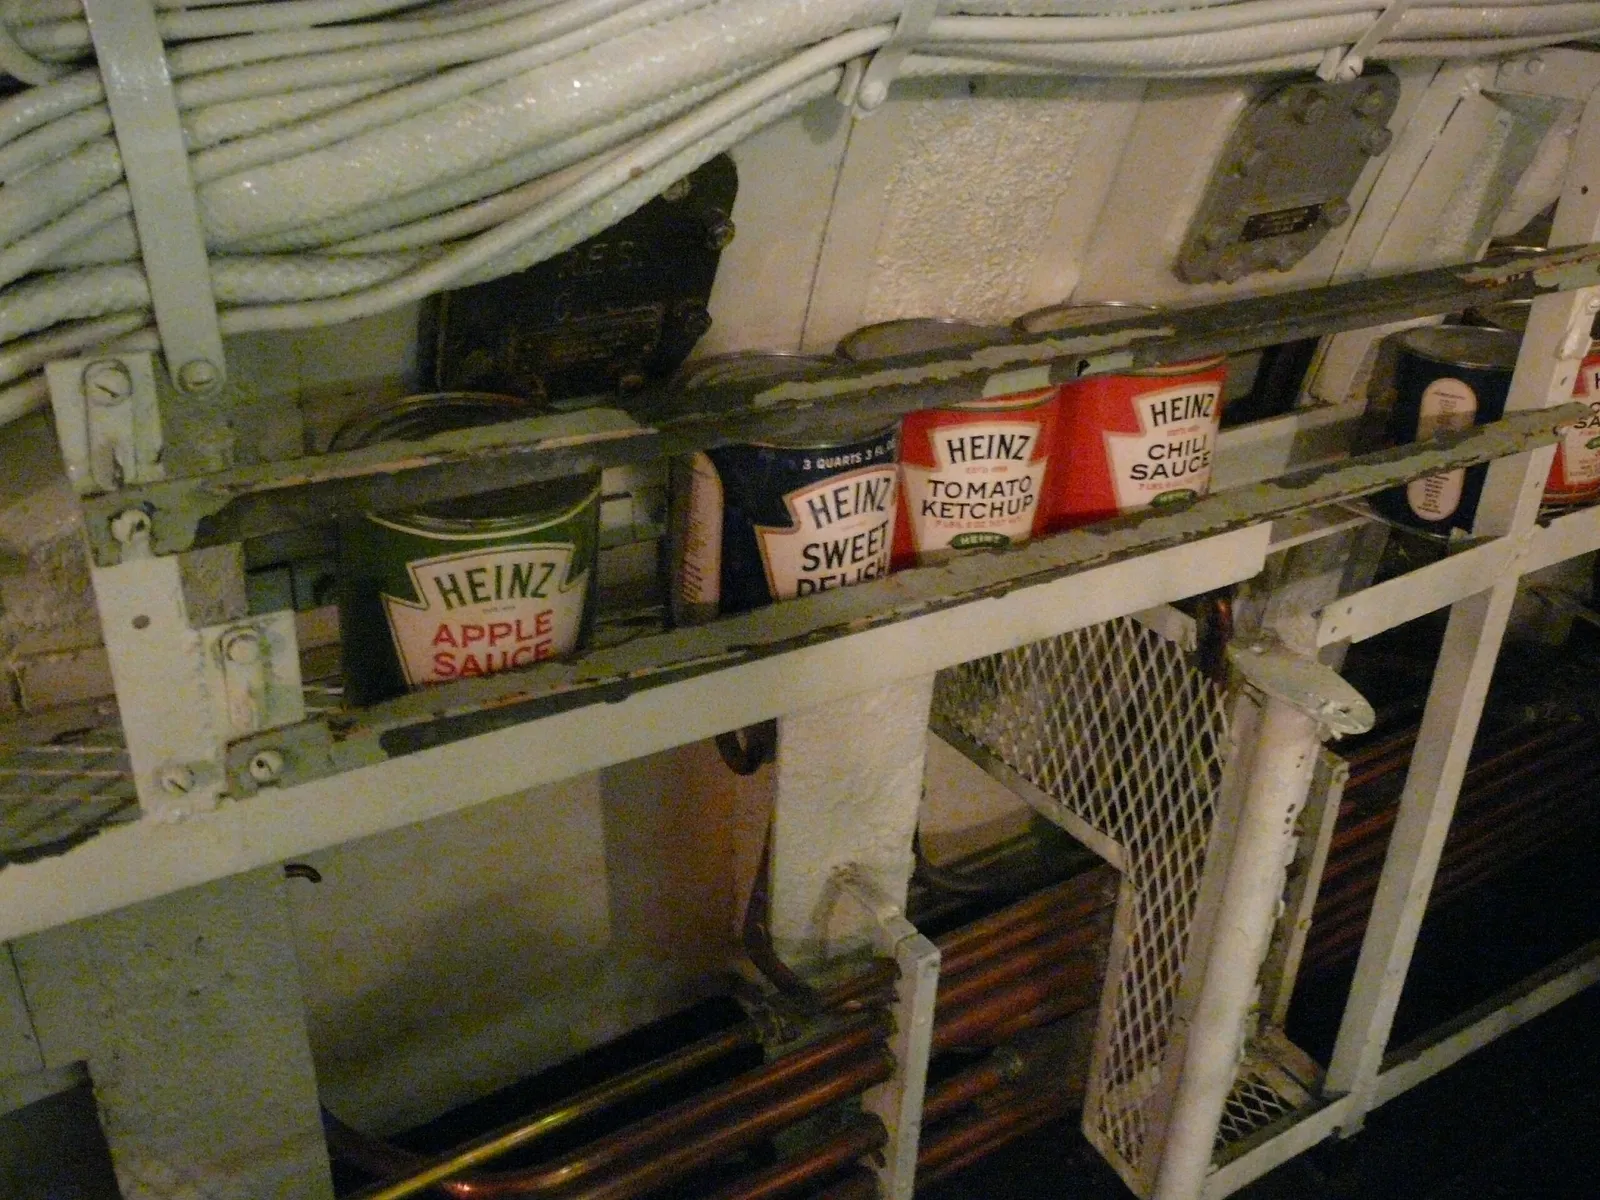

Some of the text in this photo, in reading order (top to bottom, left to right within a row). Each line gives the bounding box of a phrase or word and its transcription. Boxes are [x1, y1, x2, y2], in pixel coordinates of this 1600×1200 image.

[1150, 393, 1215, 427] HEINZ
[816, 451, 862, 469] QUARTS
[946, 434, 1031, 464] HEINZ
[1148, 434, 1208, 461] CHILI
[1130, 451, 1211, 481] SAUCE
[807, 477, 891, 529] HEINZ
[927, 475, 1032, 499] TOMATO
[921, 494, 1034, 519] KETCHUP
[802, 519, 889, 572] SWEET
[433, 562, 557, 610] HEINZ
[432, 609, 553, 648] APPLE
[433, 639, 553, 677] SAUCE
